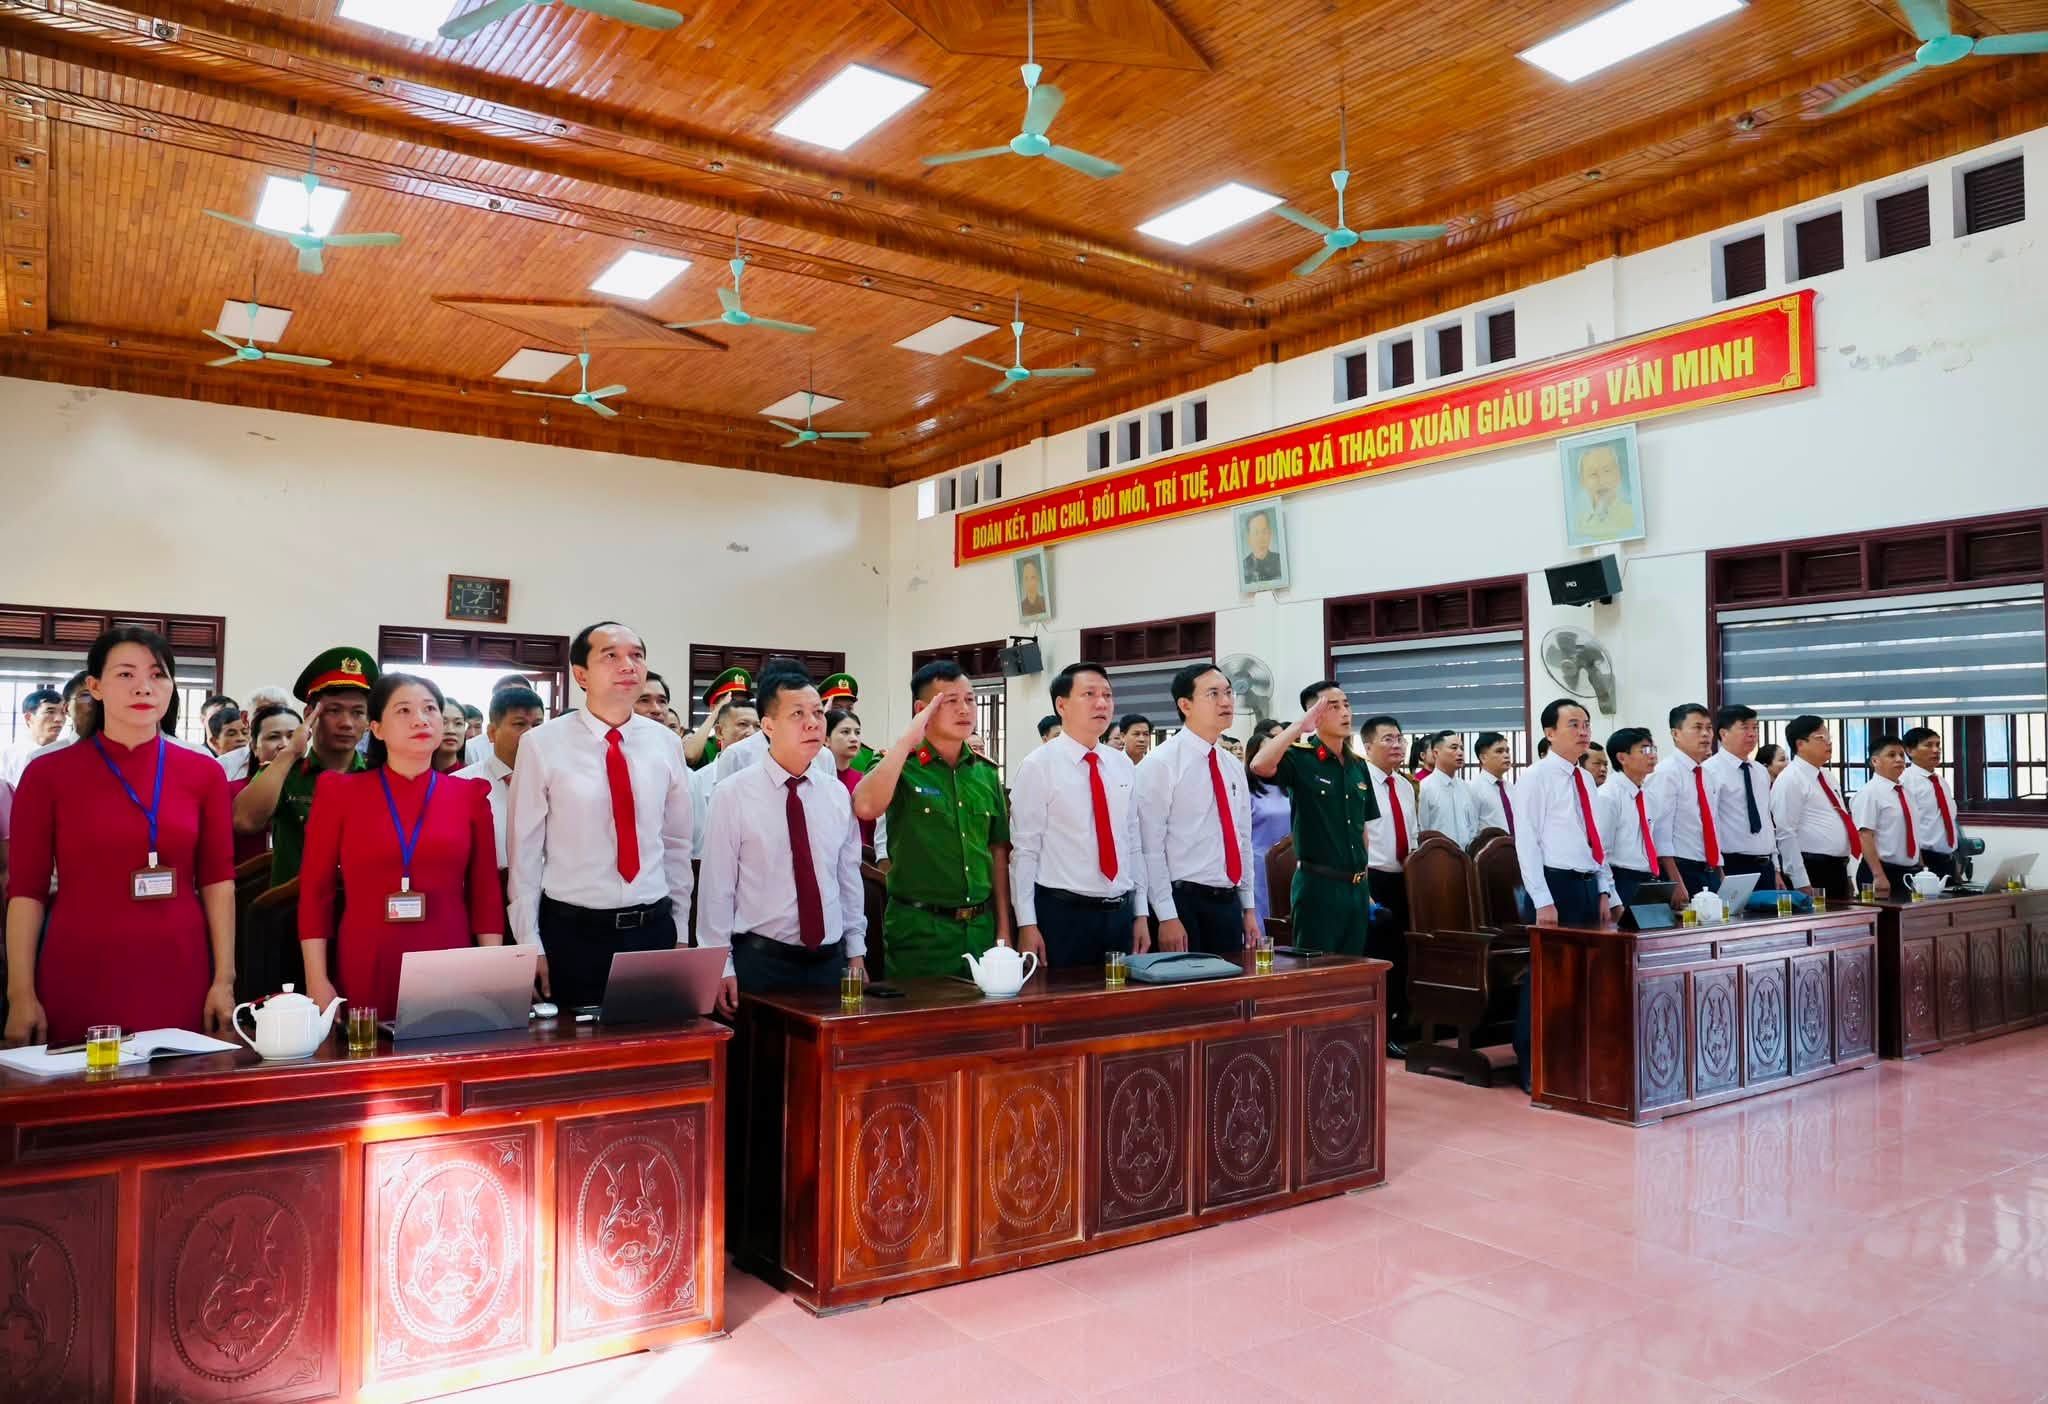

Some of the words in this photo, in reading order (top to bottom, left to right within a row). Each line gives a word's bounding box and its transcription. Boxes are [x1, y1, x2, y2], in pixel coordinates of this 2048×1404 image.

[973, 522, 1002, 549] ĐOÀN
[1005, 509, 1028, 543] KẾT,
[1032, 508, 1057, 536] DÂN
[1060, 489, 1088, 529] CHỦ,
[1092, 483, 1115, 521] ĐỔI
[1118, 478, 1150, 513] MỚI,
[1154, 471, 1176, 505] TRÍ
[1181, 464, 1213, 503] TUỆ,
[1218, 456, 1250, 492] XÂY
[1255, 447, 1303, 488] DỰNG
[1309, 432, 1334, 472] XÃ
[1339, 423, 1404, 466] THẠCH
[1410, 407, 1471, 450] XUÂN
[1477, 387, 1533, 434] GIÀU
[1541, 376, 1598, 424] ĐẸP,
[1606, 357, 1664, 406] VĂN
[1672, 336, 1754, 391] MINH
